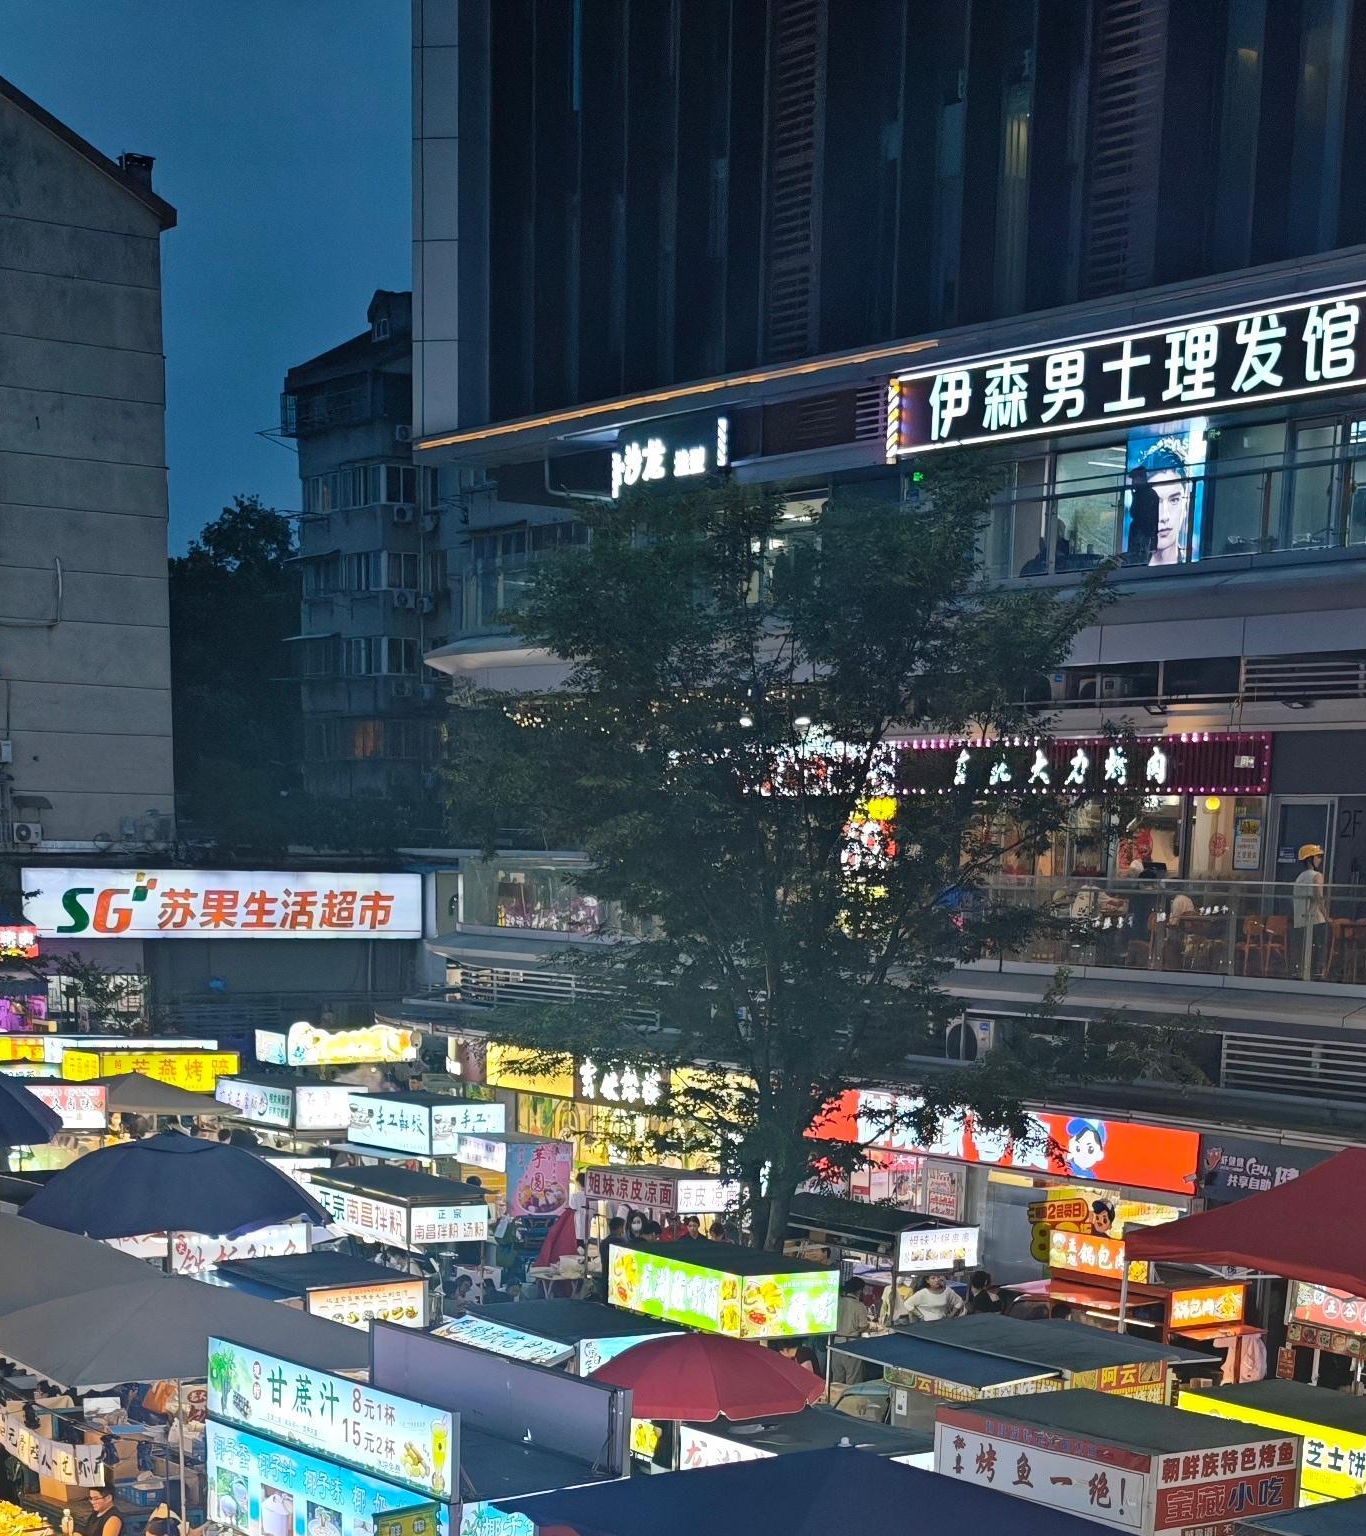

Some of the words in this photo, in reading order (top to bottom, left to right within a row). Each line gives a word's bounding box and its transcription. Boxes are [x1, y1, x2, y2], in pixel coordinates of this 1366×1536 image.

[928, 301, 1361, 441] 伊森男士理发馆
[57, 887, 134, 933] SG
[157, 888, 394, 930] 苏果生活超市
[588, 1173, 673, 1206] 姐妹凉皮凉面
[1227, 1174, 1271, 1191] 共享自助
[414, 1224, 458, 1239] 南昌拌粉
[438, 1209, 461, 1219] 正宗
[267, 1365, 340, 1426] 甘蔗汁
[352, 1387, 396, 1427] 8元1杯
[1101, 1364, 1136, 1387] 阿云
[342, 1418, 396, 1461] 15元2杯
[975, 1442, 1125, 1518] 烤鱼一绝!
[1162, 1441, 1294, 1483] 朝鲜族特色烤鱼
[1165, 1475, 1283, 1523] 宝藏小吃
